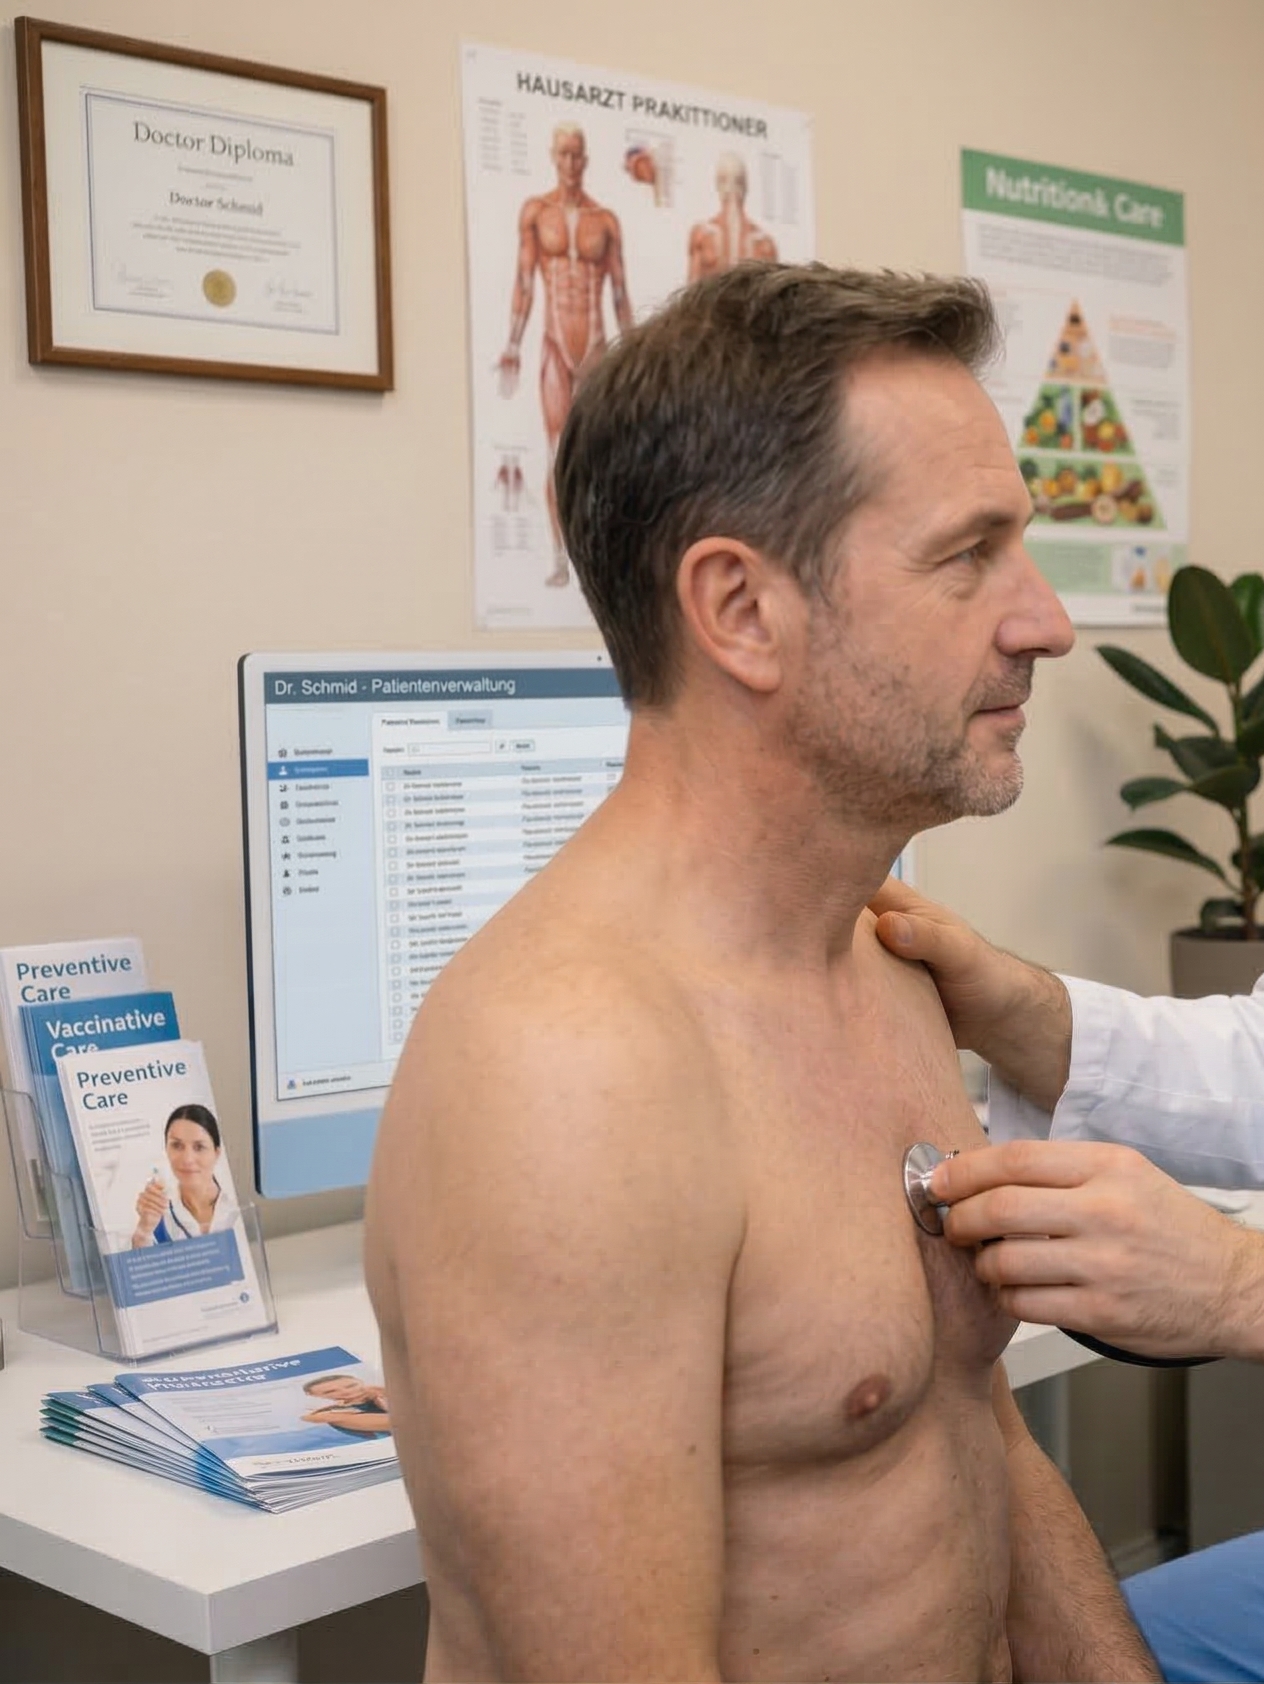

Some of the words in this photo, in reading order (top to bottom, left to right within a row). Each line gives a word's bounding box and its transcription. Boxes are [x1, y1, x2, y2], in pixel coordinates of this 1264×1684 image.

[517, 71, 627, 111] HAUSARZT
[134, 121, 205, 151] Doctor
[210, 135, 294, 166] Diploma
[274, 680, 296, 696] Dr.
[301, 679, 357, 695] Schmid
[372, 677, 516, 695] Patientenverwaltung
[16, 954, 132, 981] Preventive
[21, 985, 71, 1003] Care
[46, 1010, 166, 1040] Vaccinative
[77, 1060, 187, 1088] Preventive
[83, 1091, 128, 1110] Care
